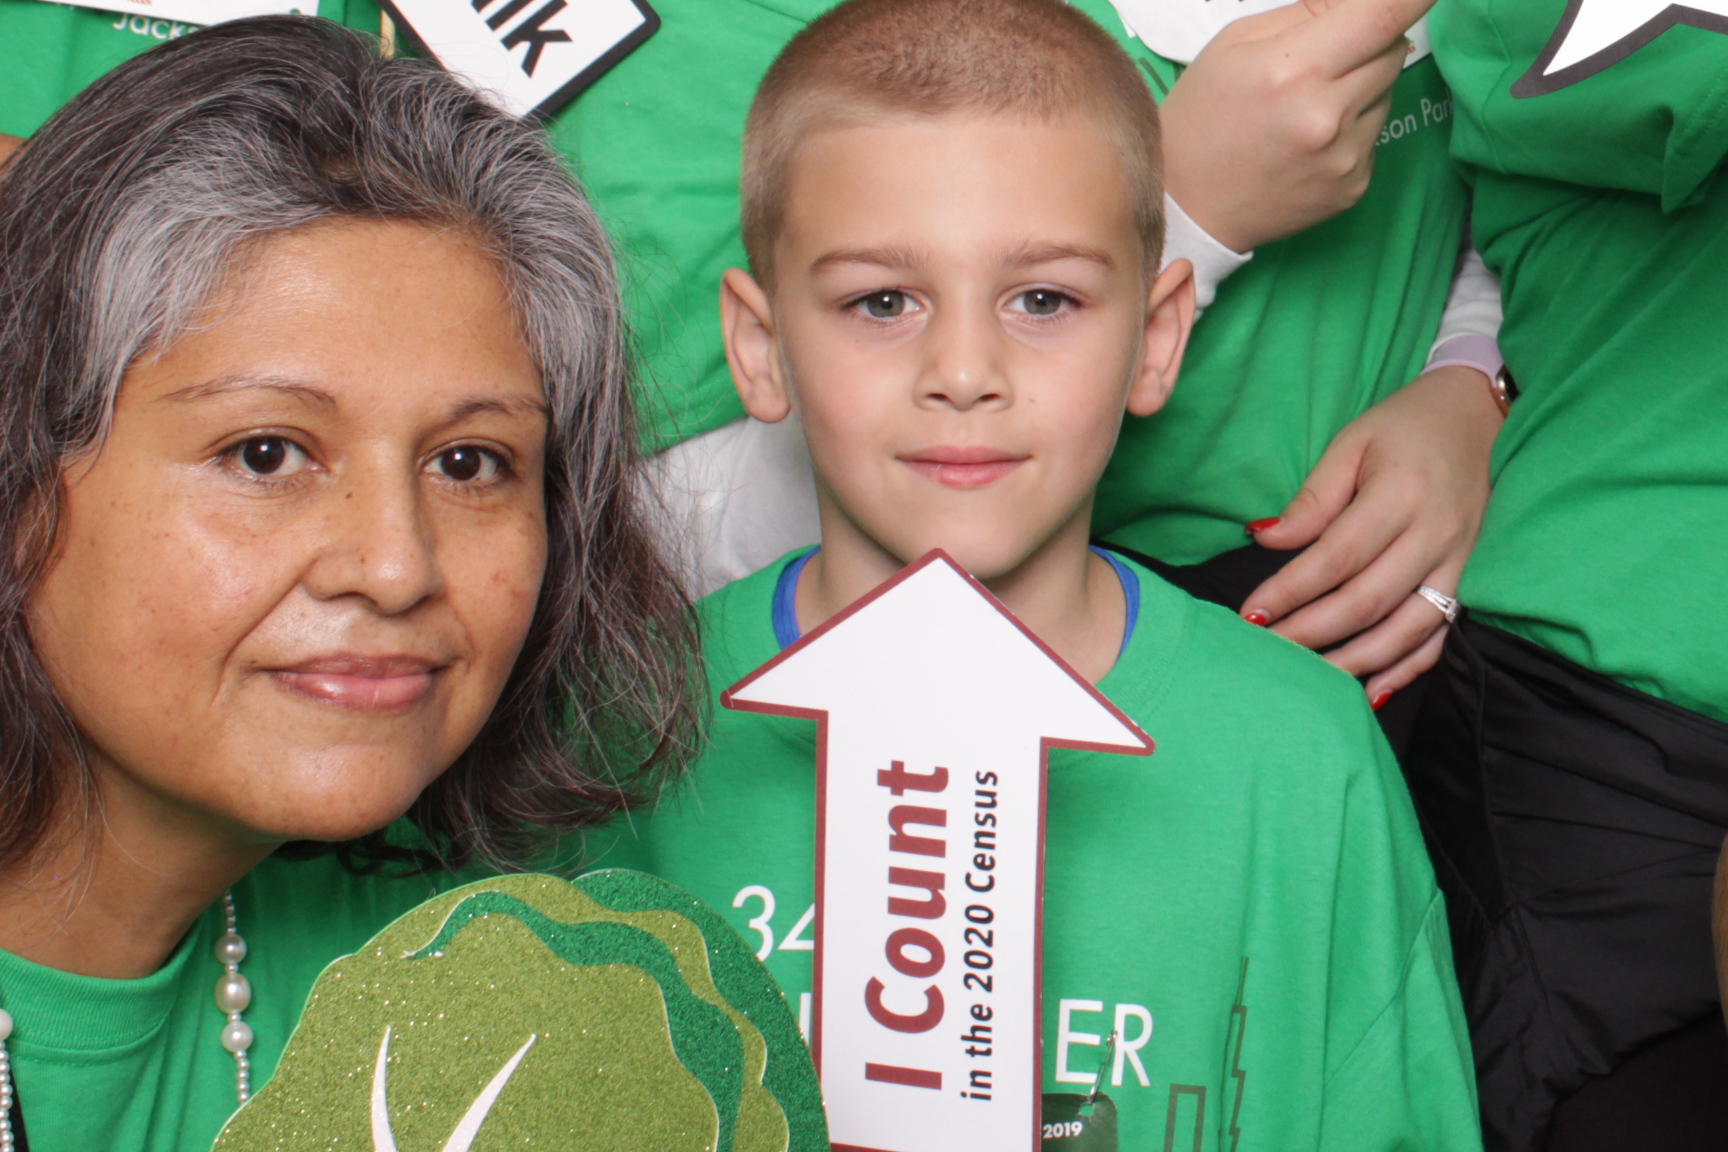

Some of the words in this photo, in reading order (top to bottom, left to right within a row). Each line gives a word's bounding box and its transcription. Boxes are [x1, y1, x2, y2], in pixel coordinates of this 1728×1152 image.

[112, 12, 199, 41] Jack
[964, 770, 998, 893] Census
[864, 759, 949, 1034] Count
[963, 904, 994, 993] 2020
[960, 1003, 993, 1058] the
[865, 1061, 943, 1091] I
[960, 1069, 992, 1101] in
[1042, 1120, 1083, 1139] 2019
